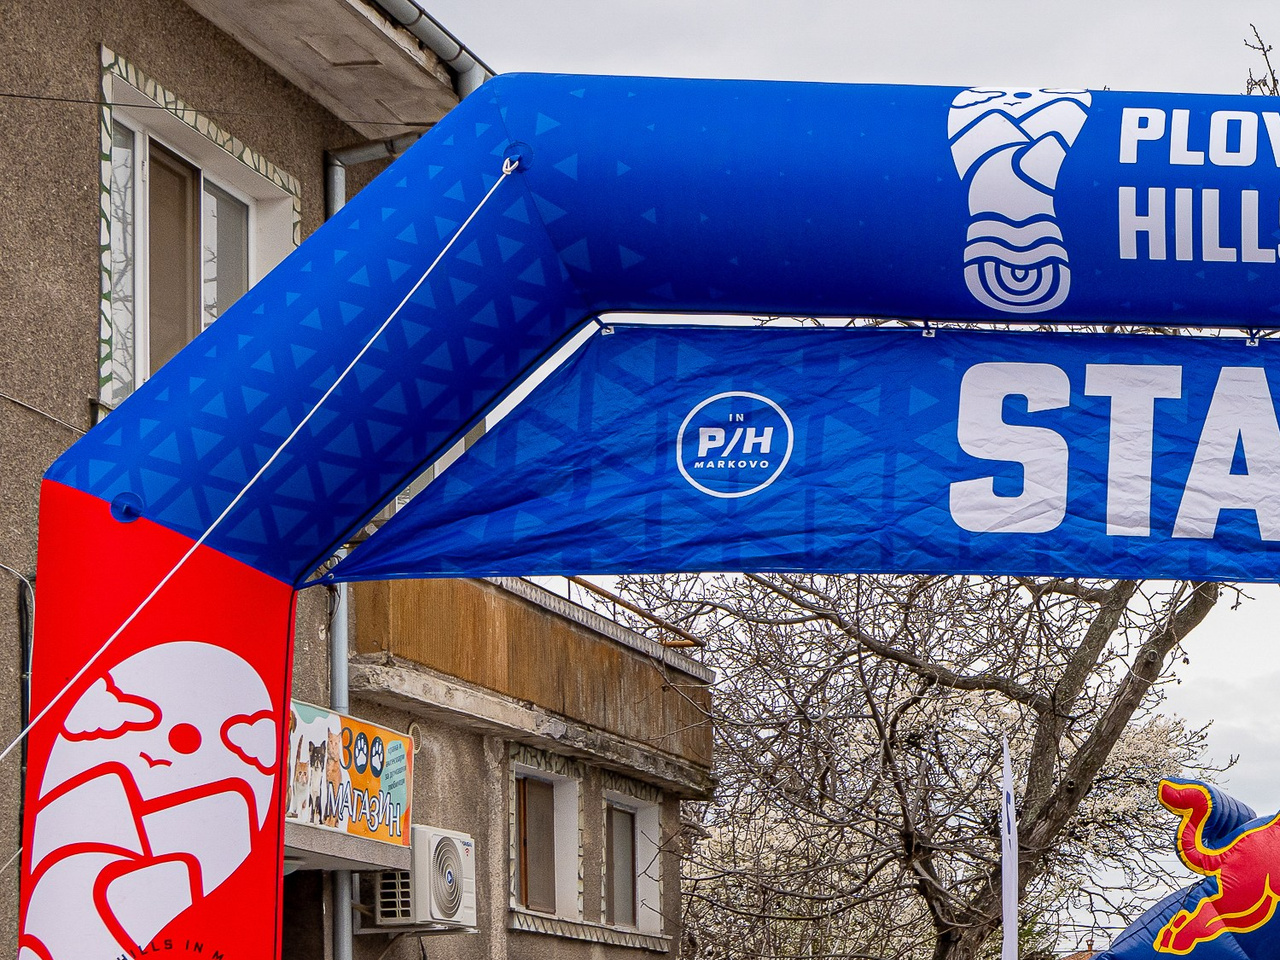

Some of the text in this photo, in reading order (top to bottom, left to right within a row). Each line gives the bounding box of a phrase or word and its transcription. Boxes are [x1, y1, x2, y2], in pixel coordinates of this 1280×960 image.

[728, 413, 744, 422] IN
[697, 426, 774, 457] P/H
[693, 460, 769, 469] MARKOVO
[326, 780, 402, 837] МАГАЗИН
[185, 939, 204, 953] IN
